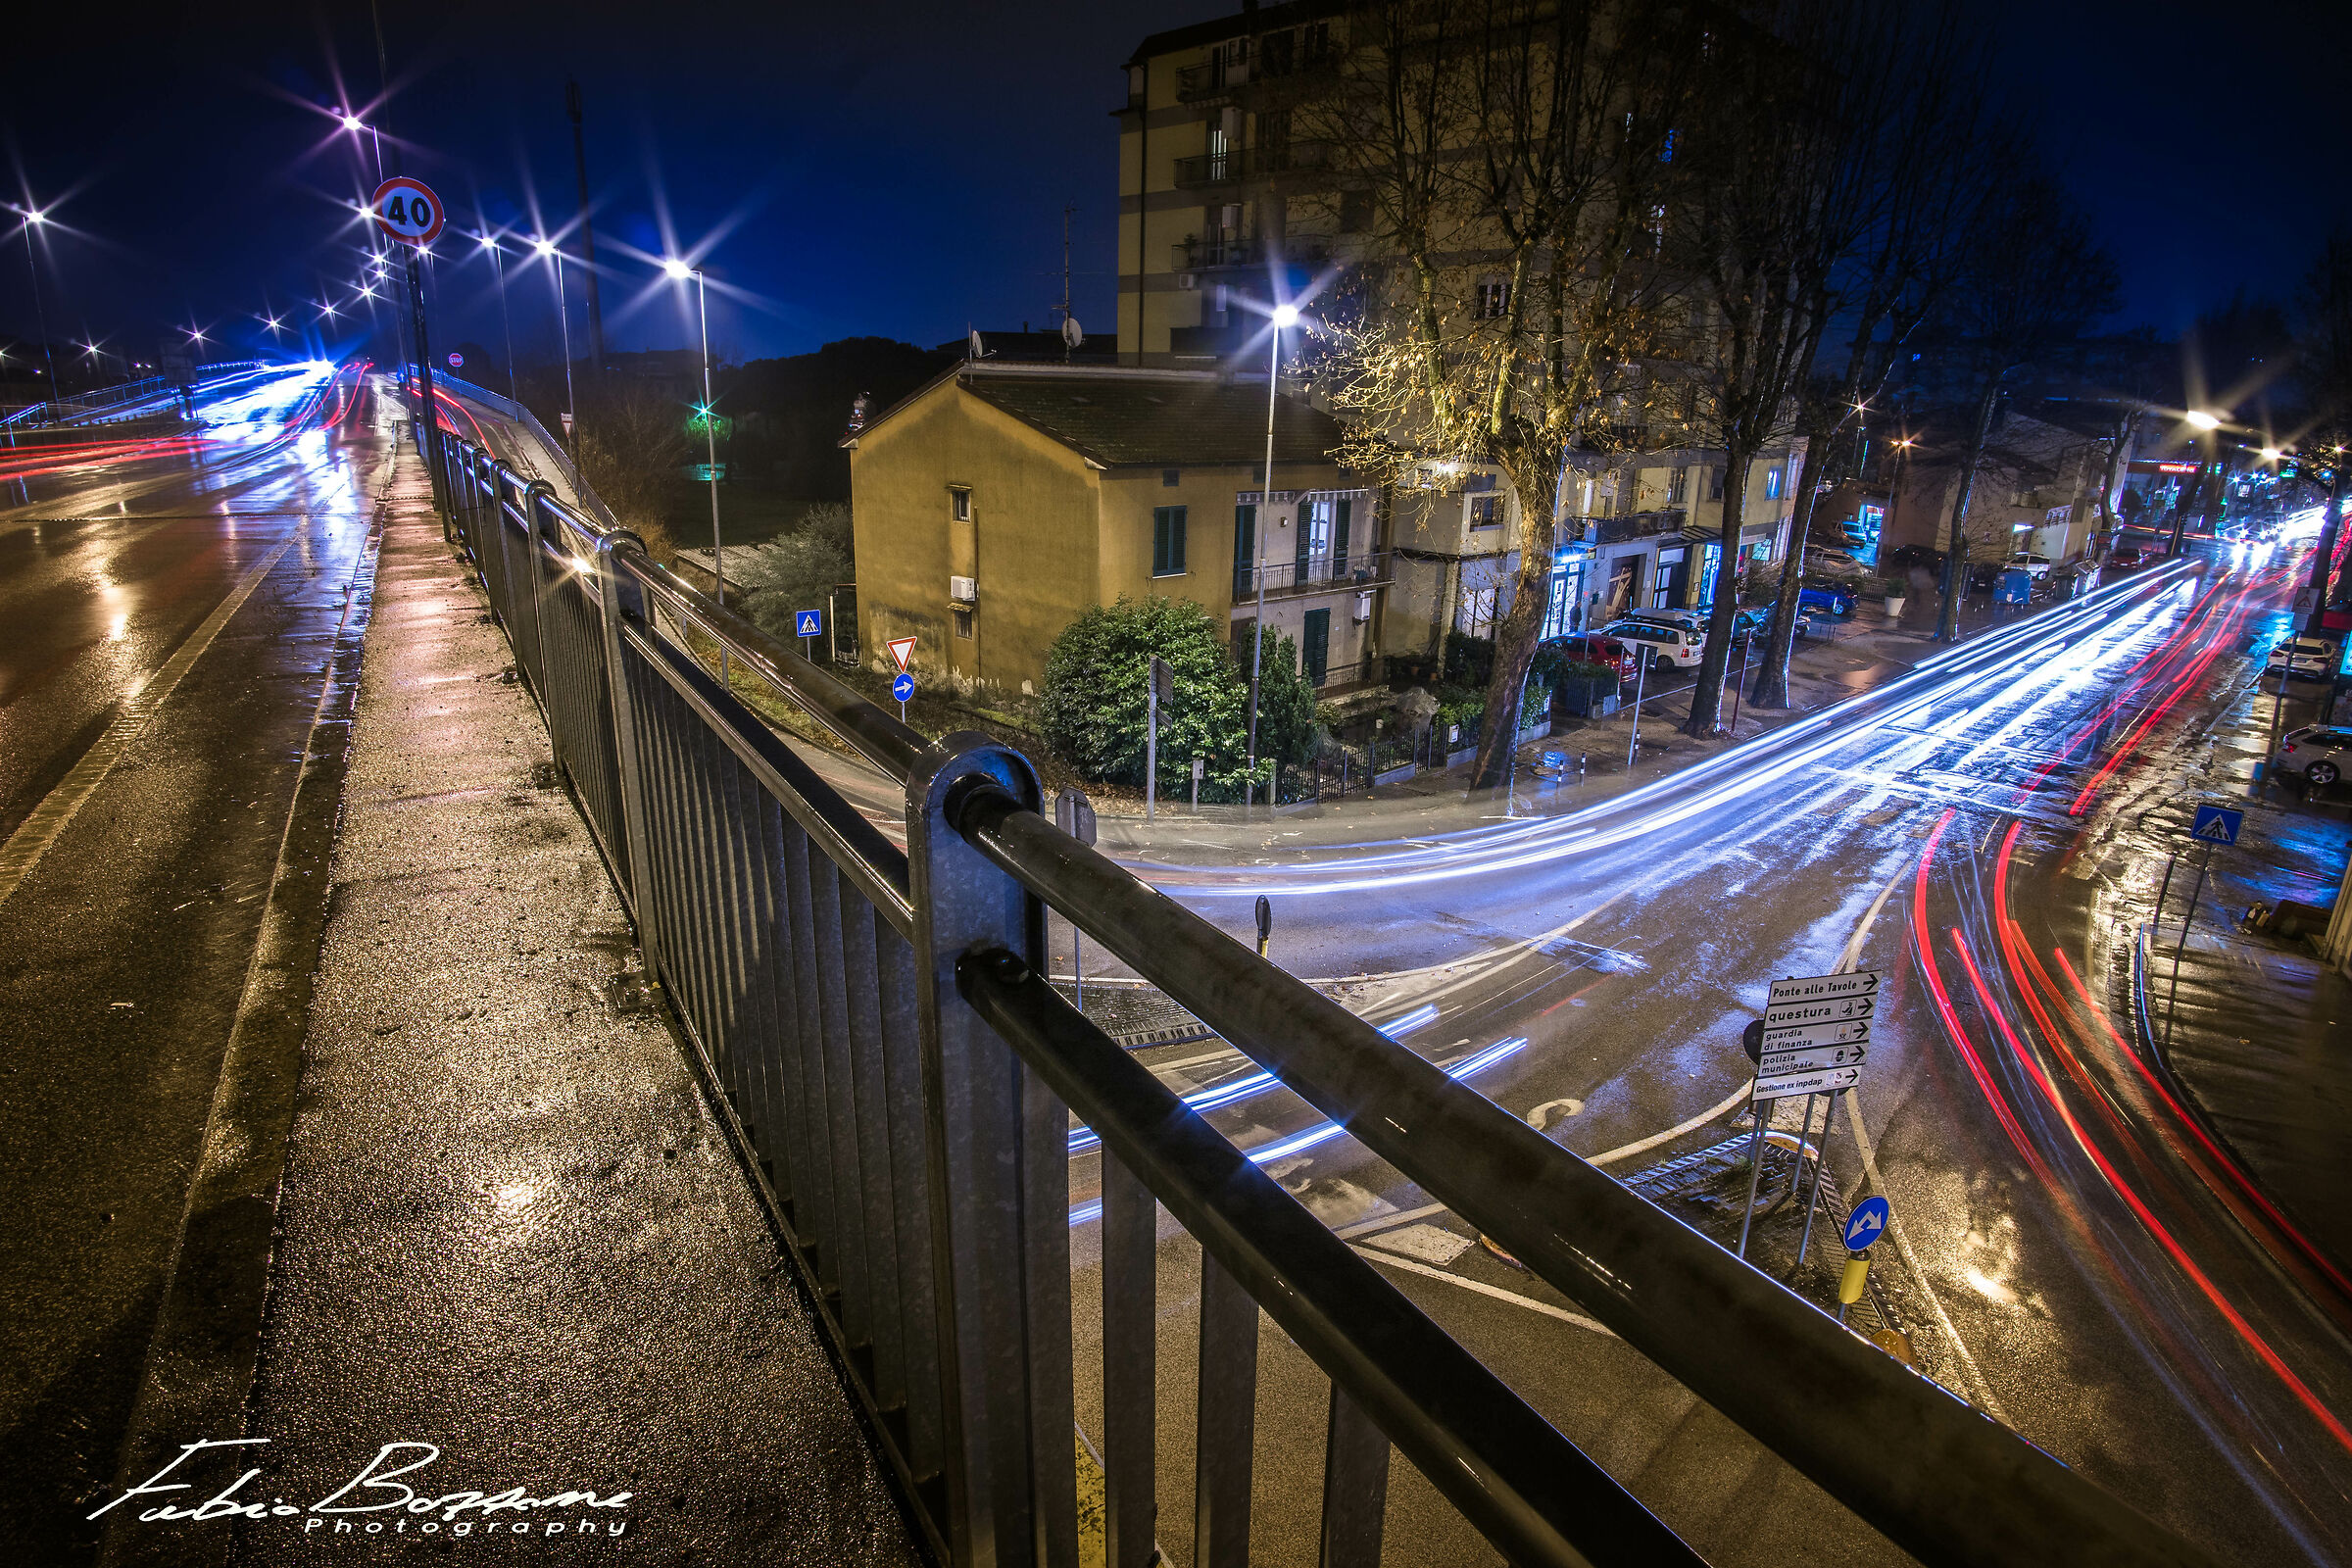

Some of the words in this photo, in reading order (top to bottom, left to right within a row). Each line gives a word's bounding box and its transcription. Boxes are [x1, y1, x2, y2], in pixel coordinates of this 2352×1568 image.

[388, 196, 431, 227] 40
[1773, 987, 1801, 998] Ponte
[1804, 984, 1824, 995] alle
[1828, 981, 1857, 993] Tavole
[1768, 1007, 1832, 1023] questura
[1766, 1029, 1802, 1041] guardia
[1777, 1039, 1813, 1050] finanza
[1763, 1054, 1795, 1065] polizia
[1761, 1061, 1814, 1074] municipale
[1756, 1083, 1786, 1094] Gestione
[1795, 1078, 1823, 1089] inpdap
